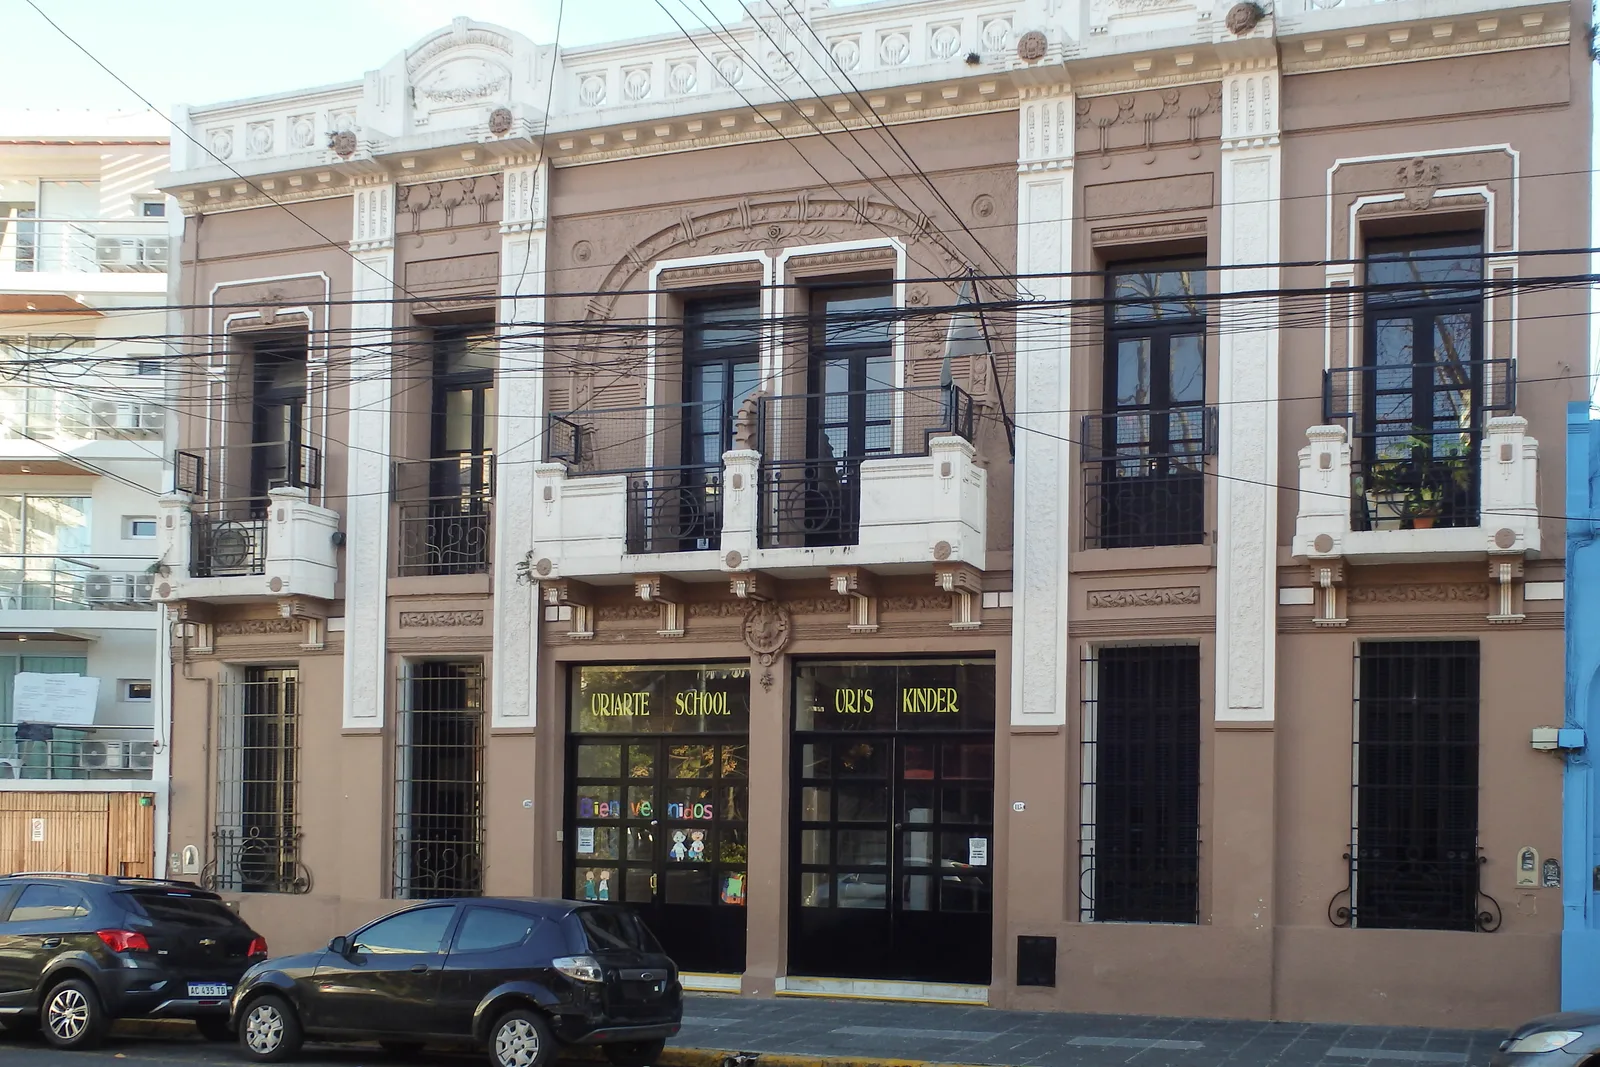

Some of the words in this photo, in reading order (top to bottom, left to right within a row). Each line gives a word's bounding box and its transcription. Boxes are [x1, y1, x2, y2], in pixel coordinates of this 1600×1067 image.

[591, 692, 650, 716] URIARTE
[675, 691, 731, 716] SCHOOL
[835, 688, 874, 713] URI'S
[902, 687, 960, 713] KINDER
[201, 986, 215, 995] 435
